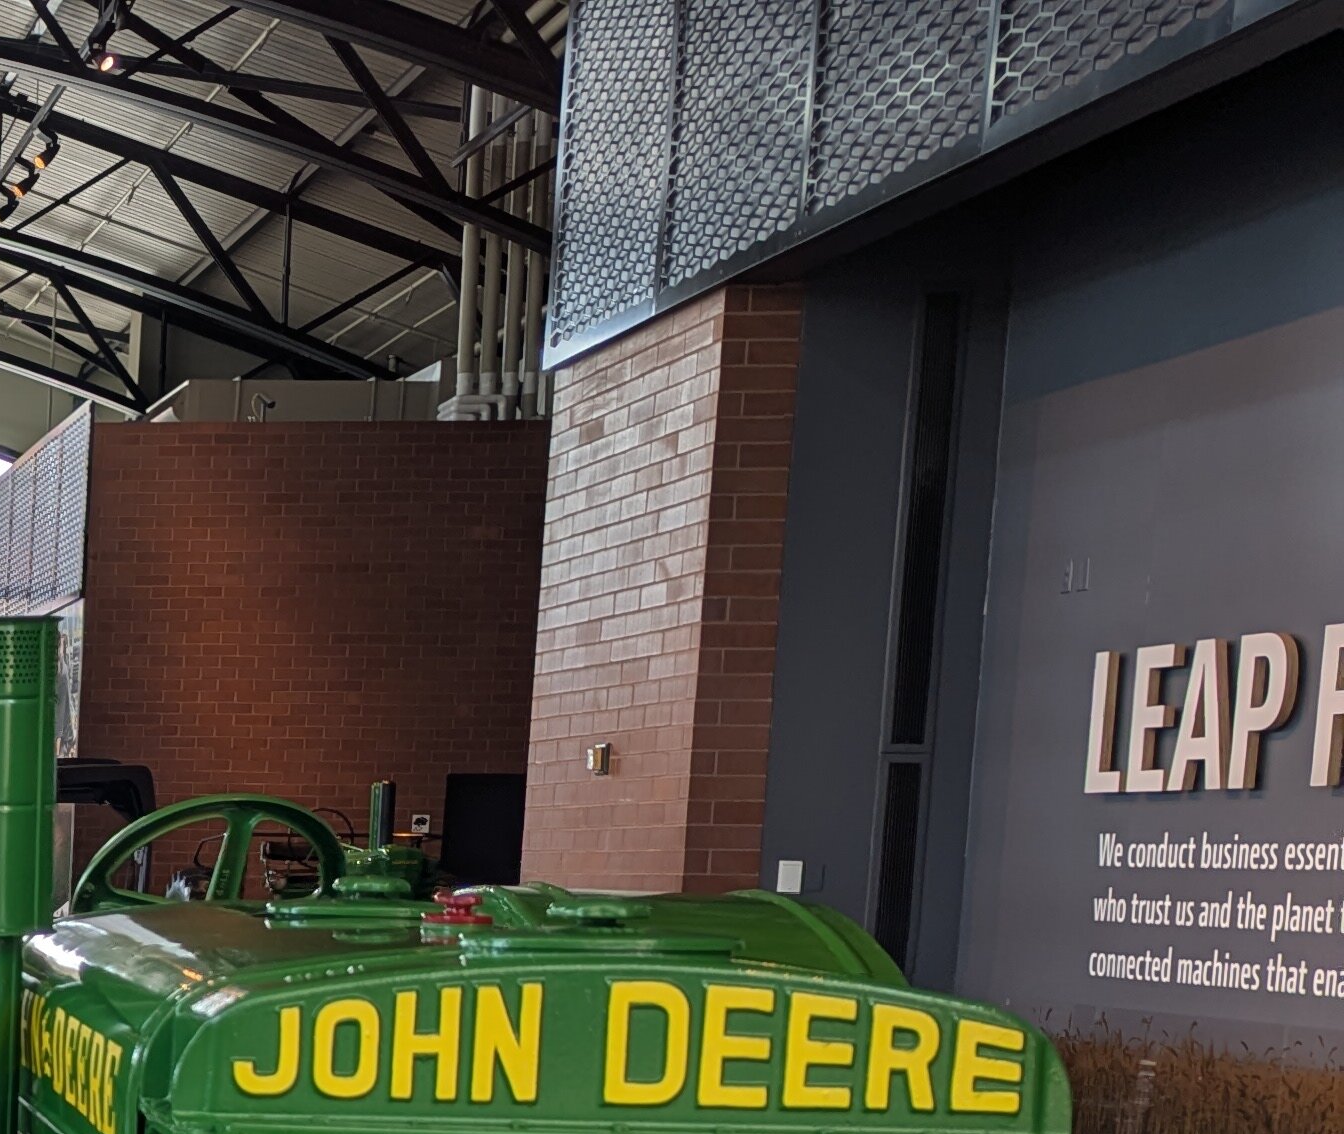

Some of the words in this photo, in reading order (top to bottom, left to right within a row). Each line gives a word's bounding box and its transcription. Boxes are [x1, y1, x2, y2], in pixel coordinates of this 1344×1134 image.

[1084, 631, 1298, 794] LEAP
[1099, 832, 1125, 869] We
[1127, 831, 1195, 869] conduct
[1200, 831, 1278, 871] business
[1093, 887, 1126, 924] who
[1131, 892, 1170, 926] trust
[1175, 897, 1195, 928] us
[1198, 890, 1231, 930] and
[1237, 893, 1266, 932] the
[1271, 892, 1334, 943] planet
[1089, 945, 1174, 985] connected
[1177, 949, 1260, 992] machines
[1267, 952, 1308, 997] that
[21, 988, 46, 1078] HN
[233, 982, 543, 1104] JOHN
[602, 979, 1025, 1114] DEERE
